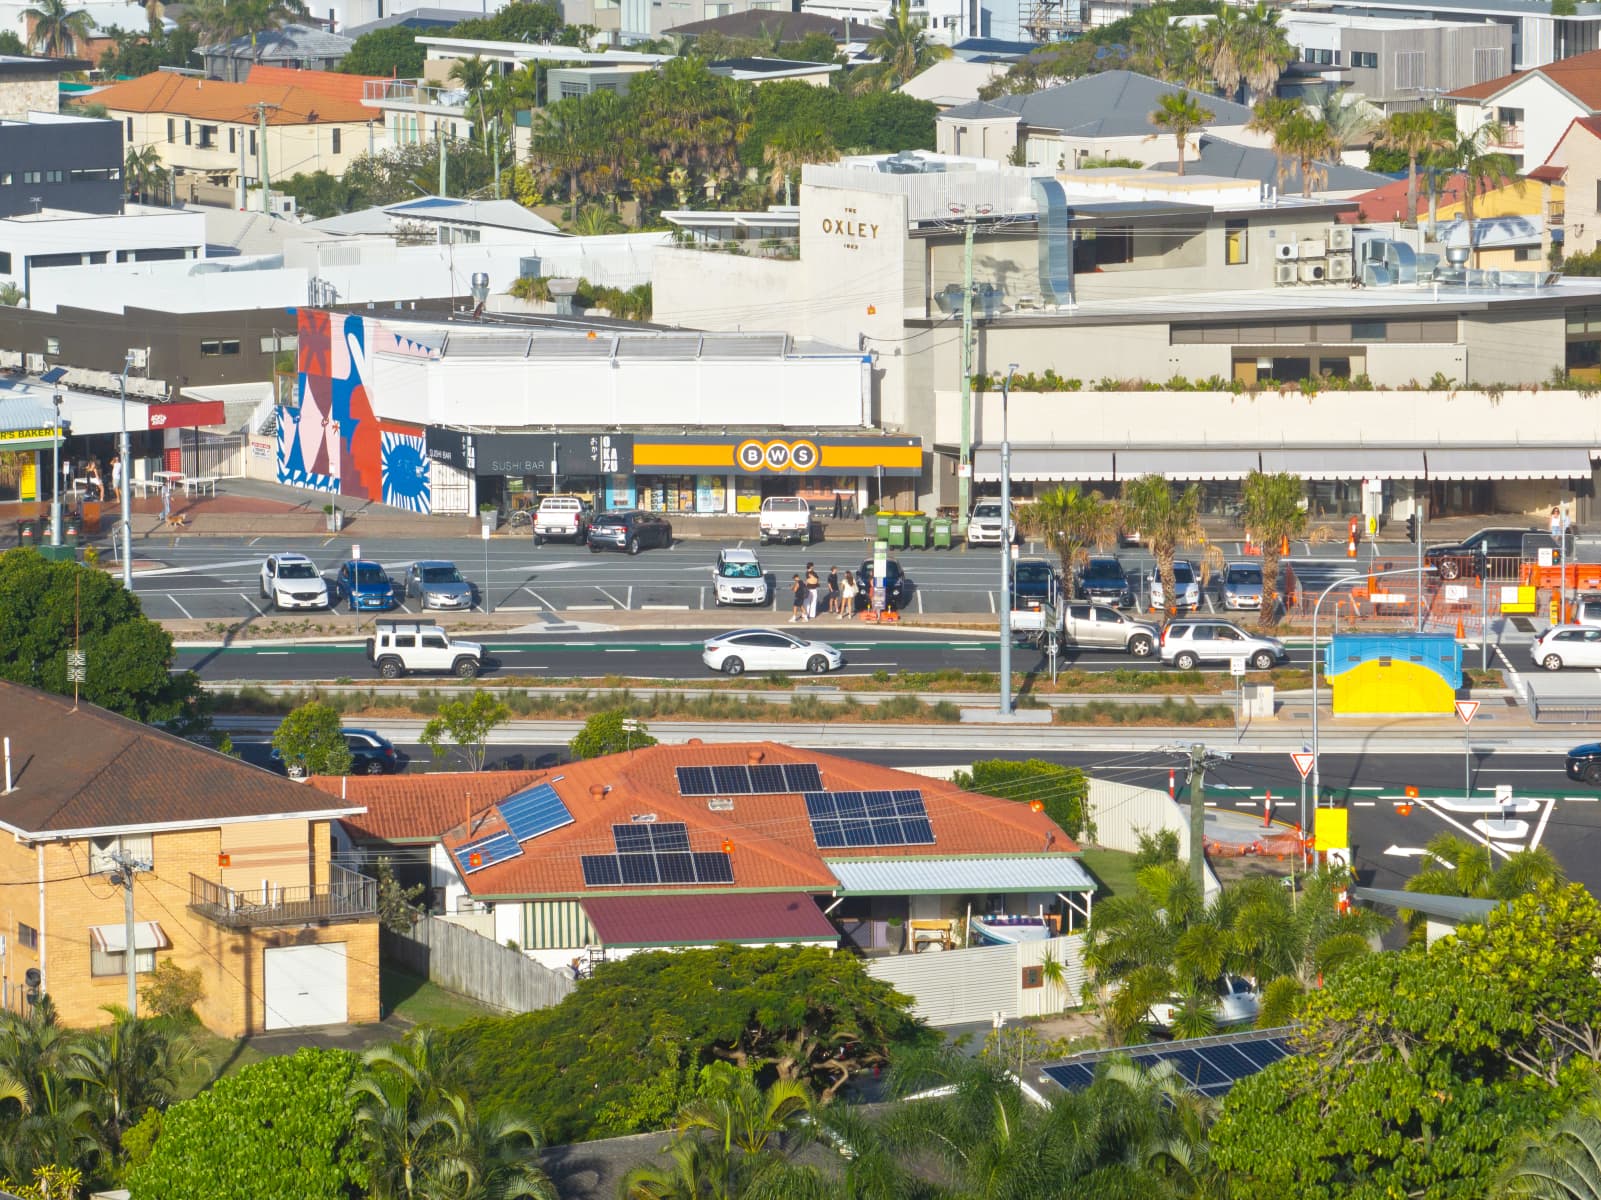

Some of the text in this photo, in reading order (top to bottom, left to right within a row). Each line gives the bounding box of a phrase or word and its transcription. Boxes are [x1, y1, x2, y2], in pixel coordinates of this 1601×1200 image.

[822, 218, 879, 239] OXLEY
[747, 449, 808, 462] BWS
[492, 460, 545, 471] SUSHI BAR
